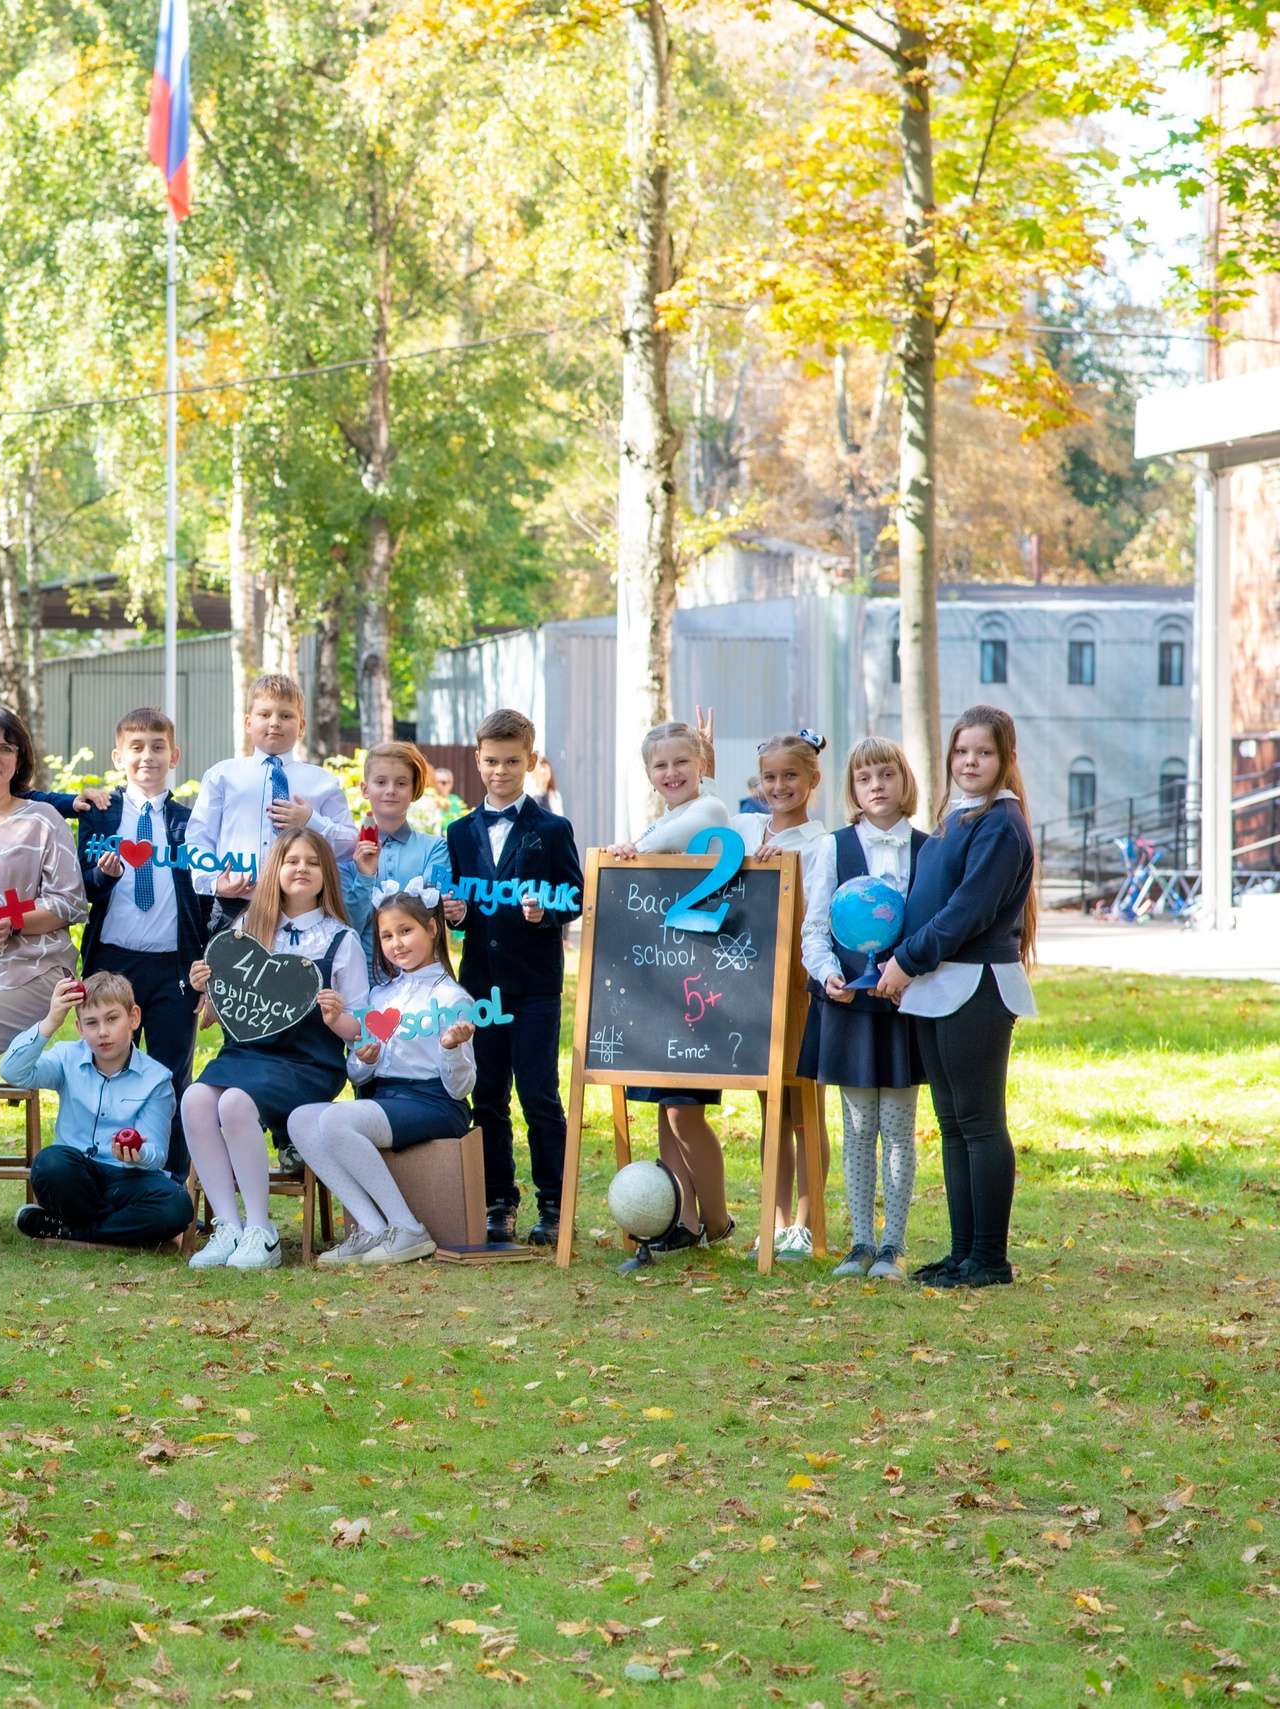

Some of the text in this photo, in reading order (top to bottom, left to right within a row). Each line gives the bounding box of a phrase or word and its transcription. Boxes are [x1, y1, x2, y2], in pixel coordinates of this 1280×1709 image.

[628, 884, 679, 915] Bac
[665, 827, 745, 932] 2
[221, 998, 273, 1035] 2024
[684, 973, 722, 1022] 5+
